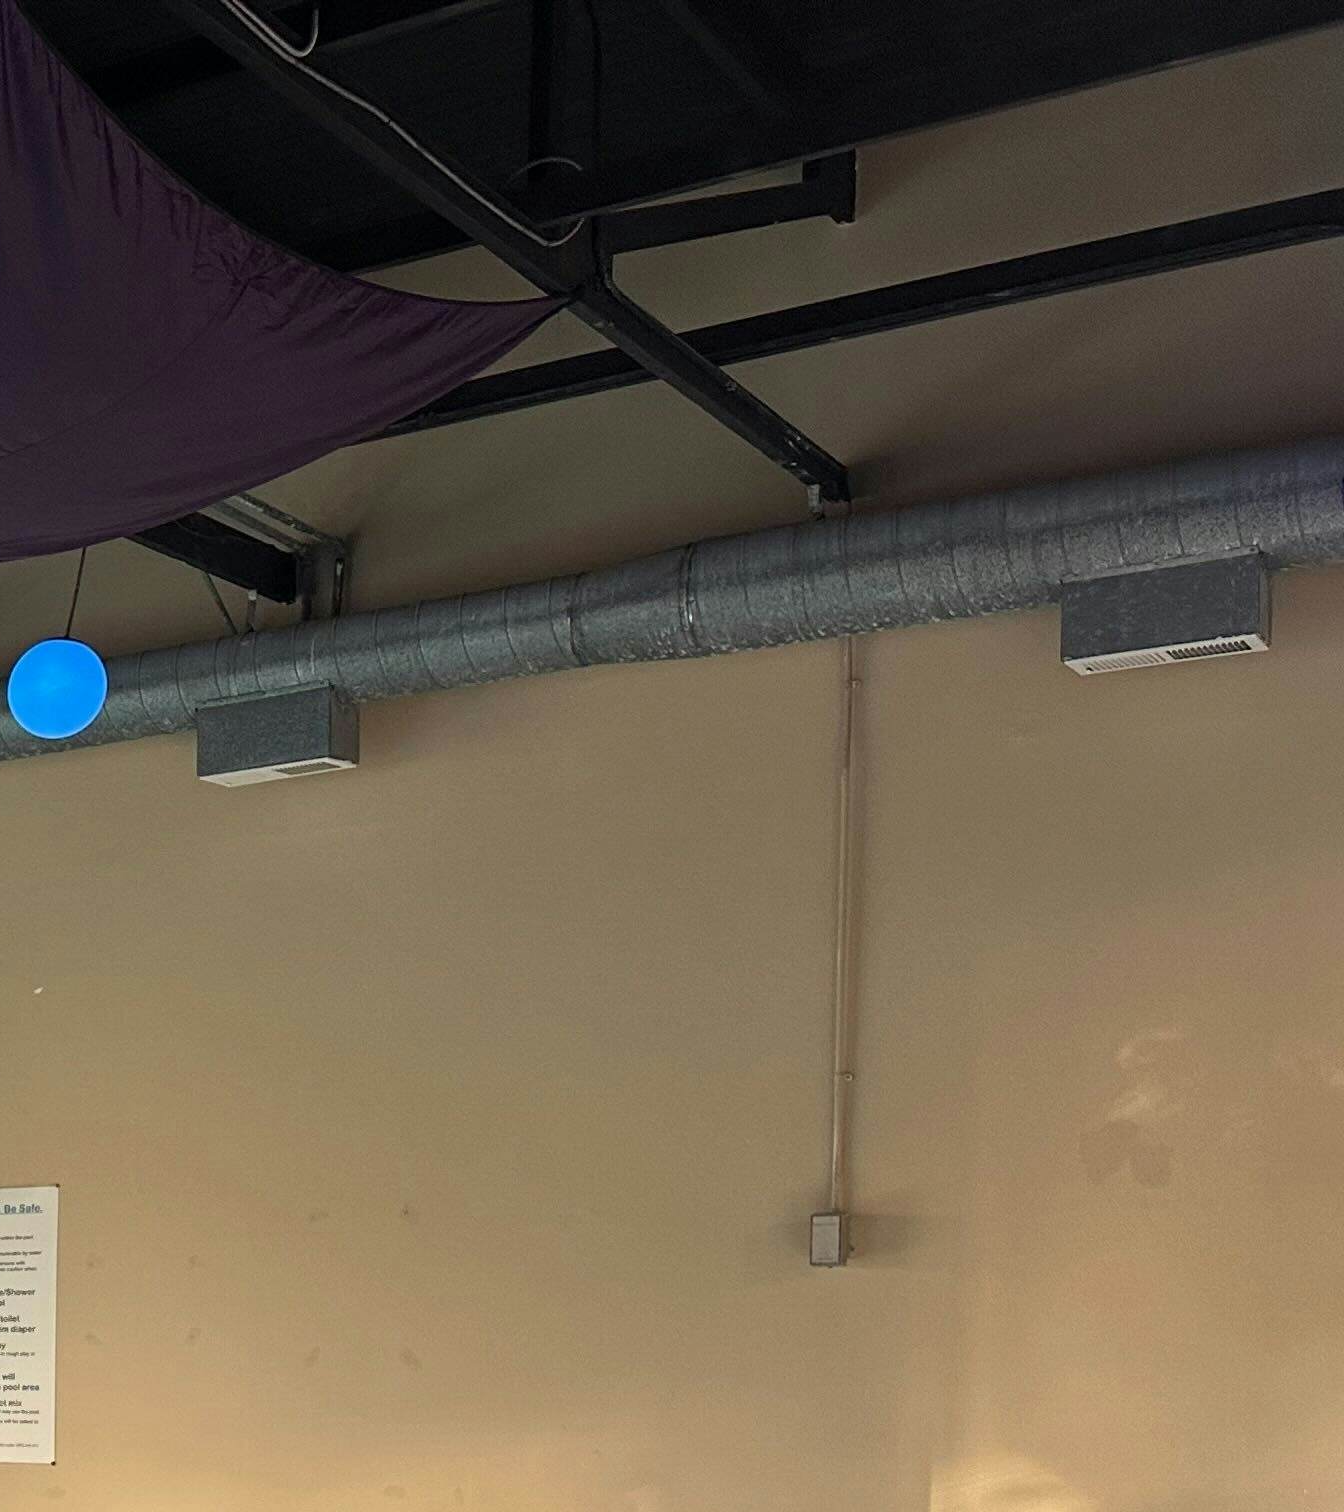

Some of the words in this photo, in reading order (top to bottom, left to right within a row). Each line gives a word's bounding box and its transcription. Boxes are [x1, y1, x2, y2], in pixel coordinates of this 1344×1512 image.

[4, 1204, 17, 1214] Be
[10, 1326, 36, 1334] diaper
[3, 1384, 20, 1392] pool
